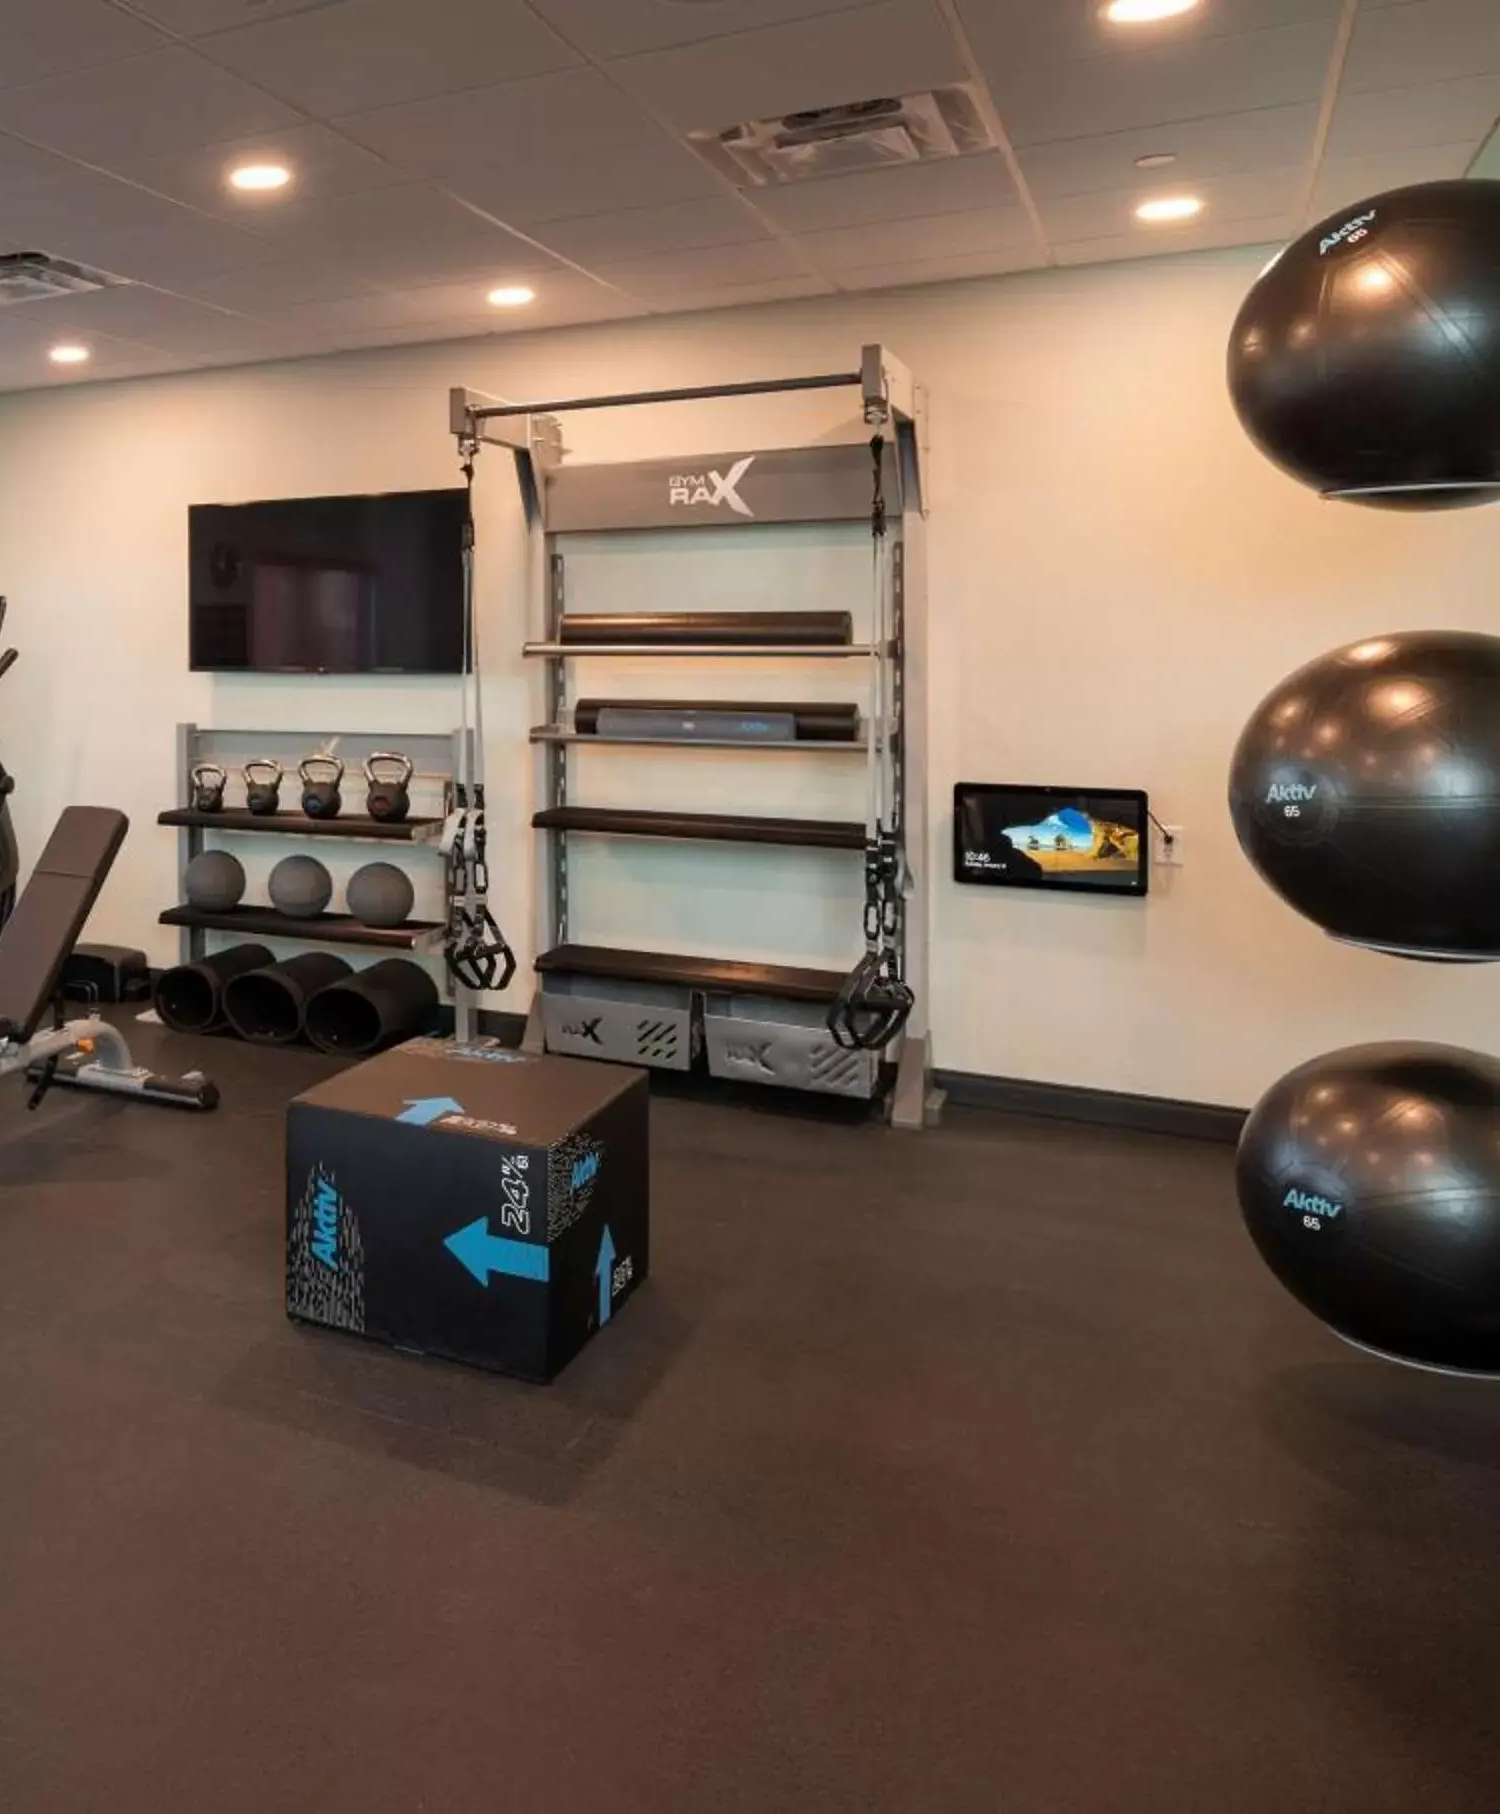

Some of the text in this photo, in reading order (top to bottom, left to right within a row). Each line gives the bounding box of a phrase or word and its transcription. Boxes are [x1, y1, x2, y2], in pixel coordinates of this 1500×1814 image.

[1319, 209, 1376, 255] Aktiv
[1266, 783, 1317, 803] Aktiv
[1284, 805, 1300, 816] 65
[1283, 1188, 1342, 1218] Aktiv
[312, 1177, 339, 1271] Aktiv
[1303, 1215, 1321, 1230] 65
